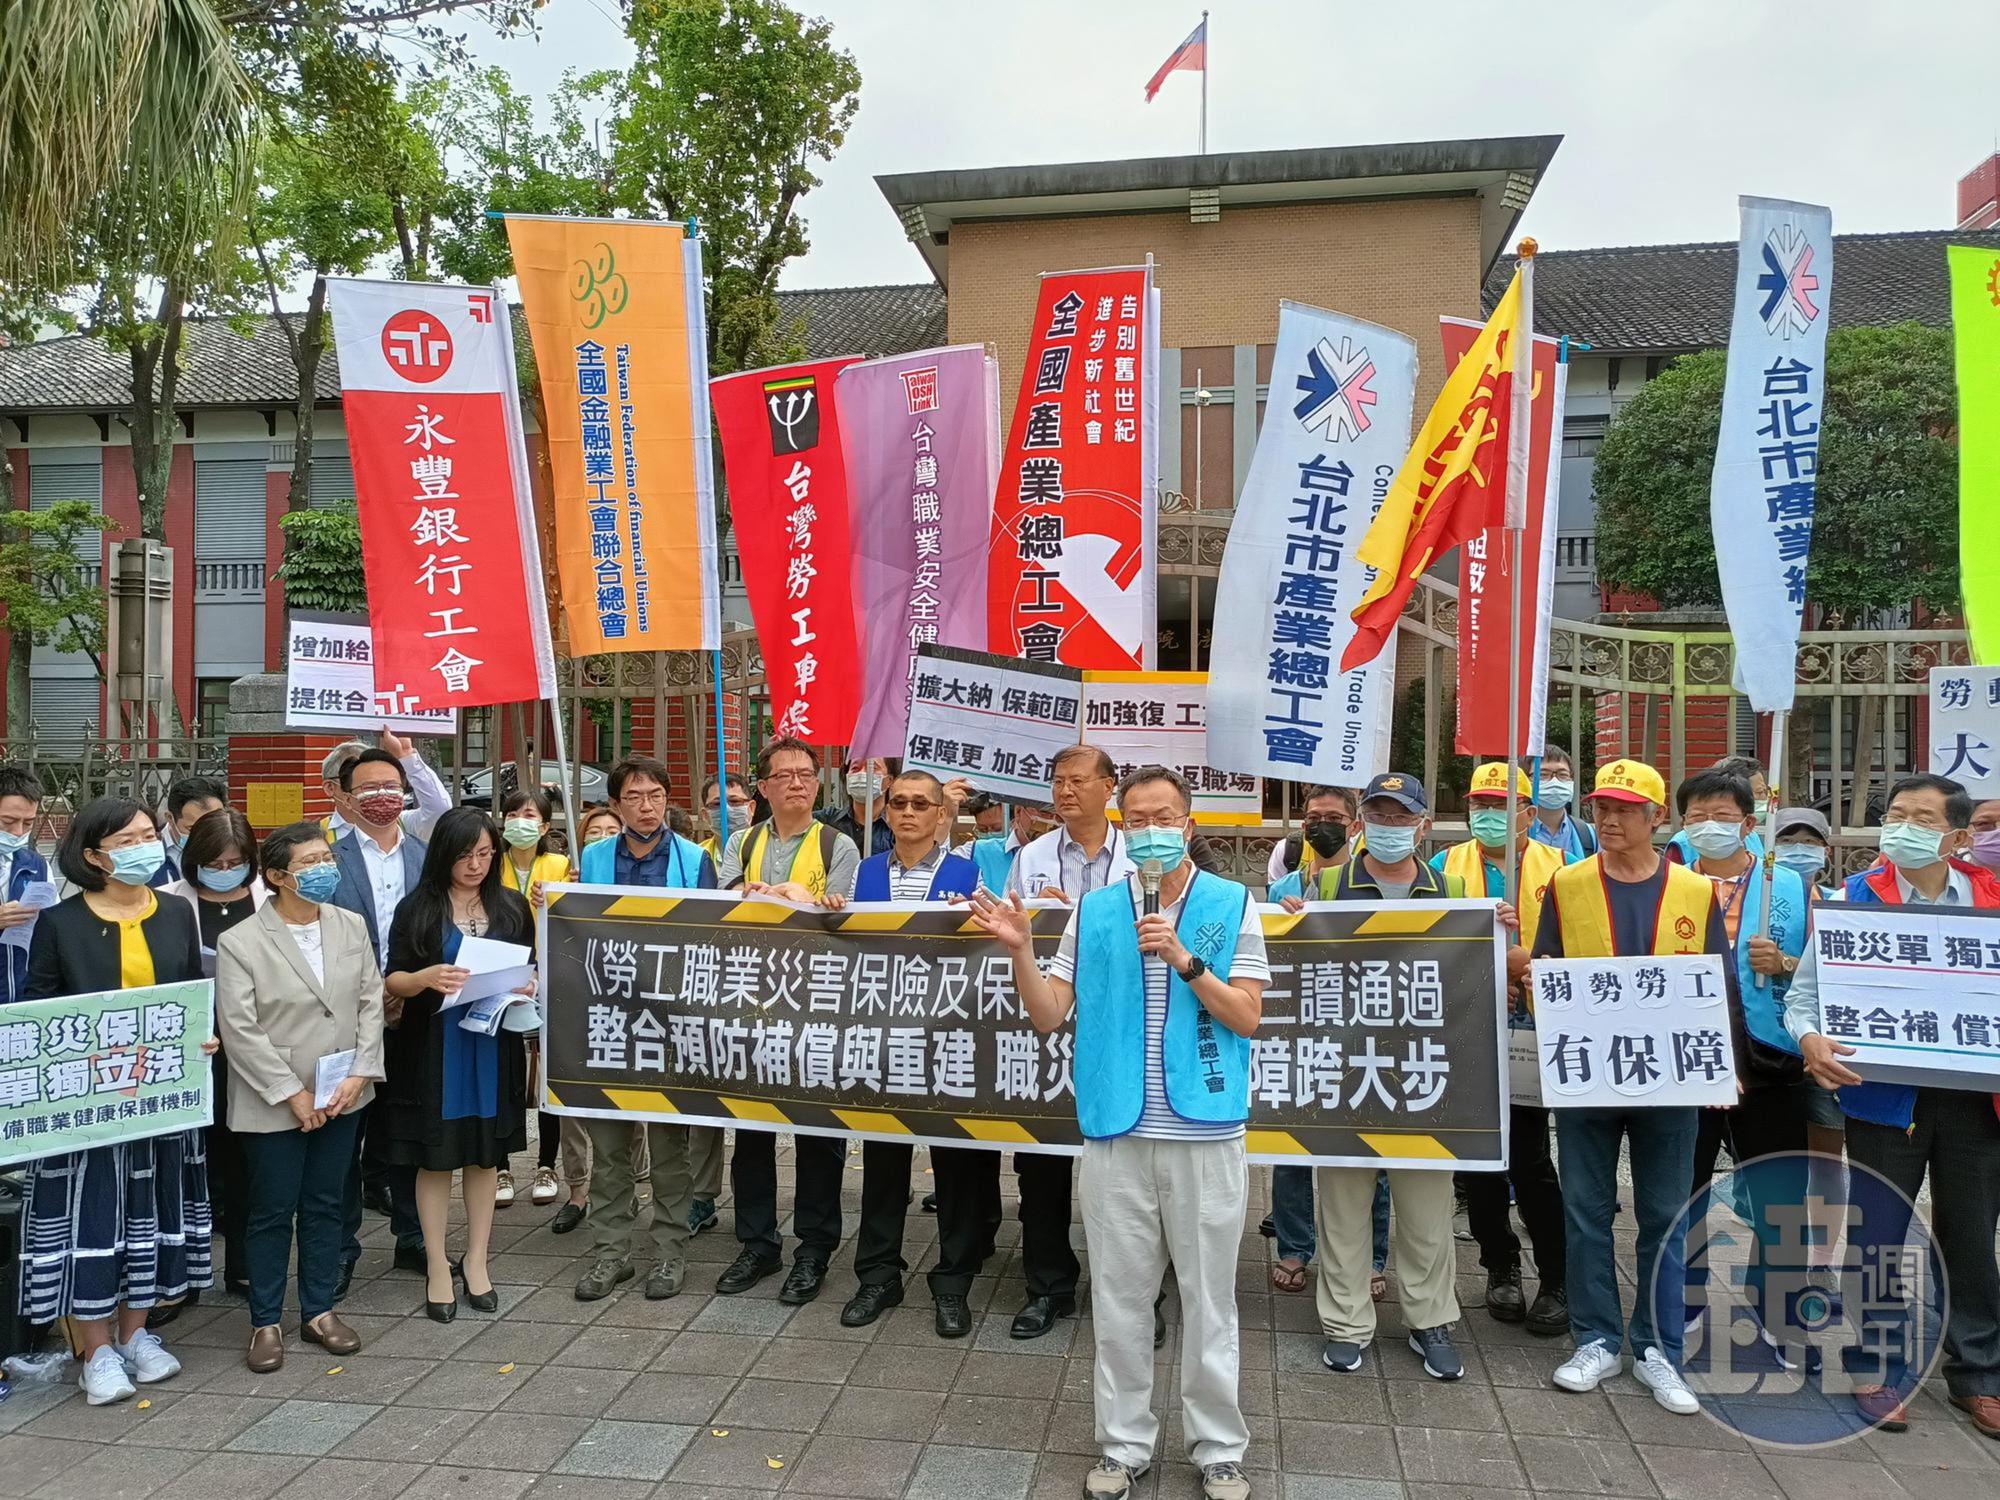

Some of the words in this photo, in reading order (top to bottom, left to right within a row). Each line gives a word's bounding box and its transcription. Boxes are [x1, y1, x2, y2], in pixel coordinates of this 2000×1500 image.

[616, 343, 630, 400] Taiwan
[1085, 296, 1114, 445] 進步新社會
[1114, 294, 1138, 443] 告別舊世紀
[620, 404, 638, 488] Federation
[575, 339, 628, 639] 全國金融業工會聯合總會
[628, 491, 641, 508] of
[1017, 290, 1086, 664] 全國產業總工會
[403, 403, 484, 693] 永豐銀行工會
[635, 580, 649, 632] Unions
[1262, 453, 1355, 766] 台北市產業總工會
[1086, 700, 1206, 727] 加強復工
[1346, 670, 1367, 714] Trade
[1341, 721, 1362, 772] Unions
[1540, 966, 1718, 1005] 弱勢勞工
[0, 1001, 188, 1065] 職災保險
[586, 1003, 977, 1098] 整合預防補償與重建
[1824, 1004, 2000, 1048] 整合補償
[0, 1044, 185, 1109] 單獨立法
[1543, 1030, 1729, 1086] 有保障
[0, 1088, 201, 1141] 備職業健康保護機制
